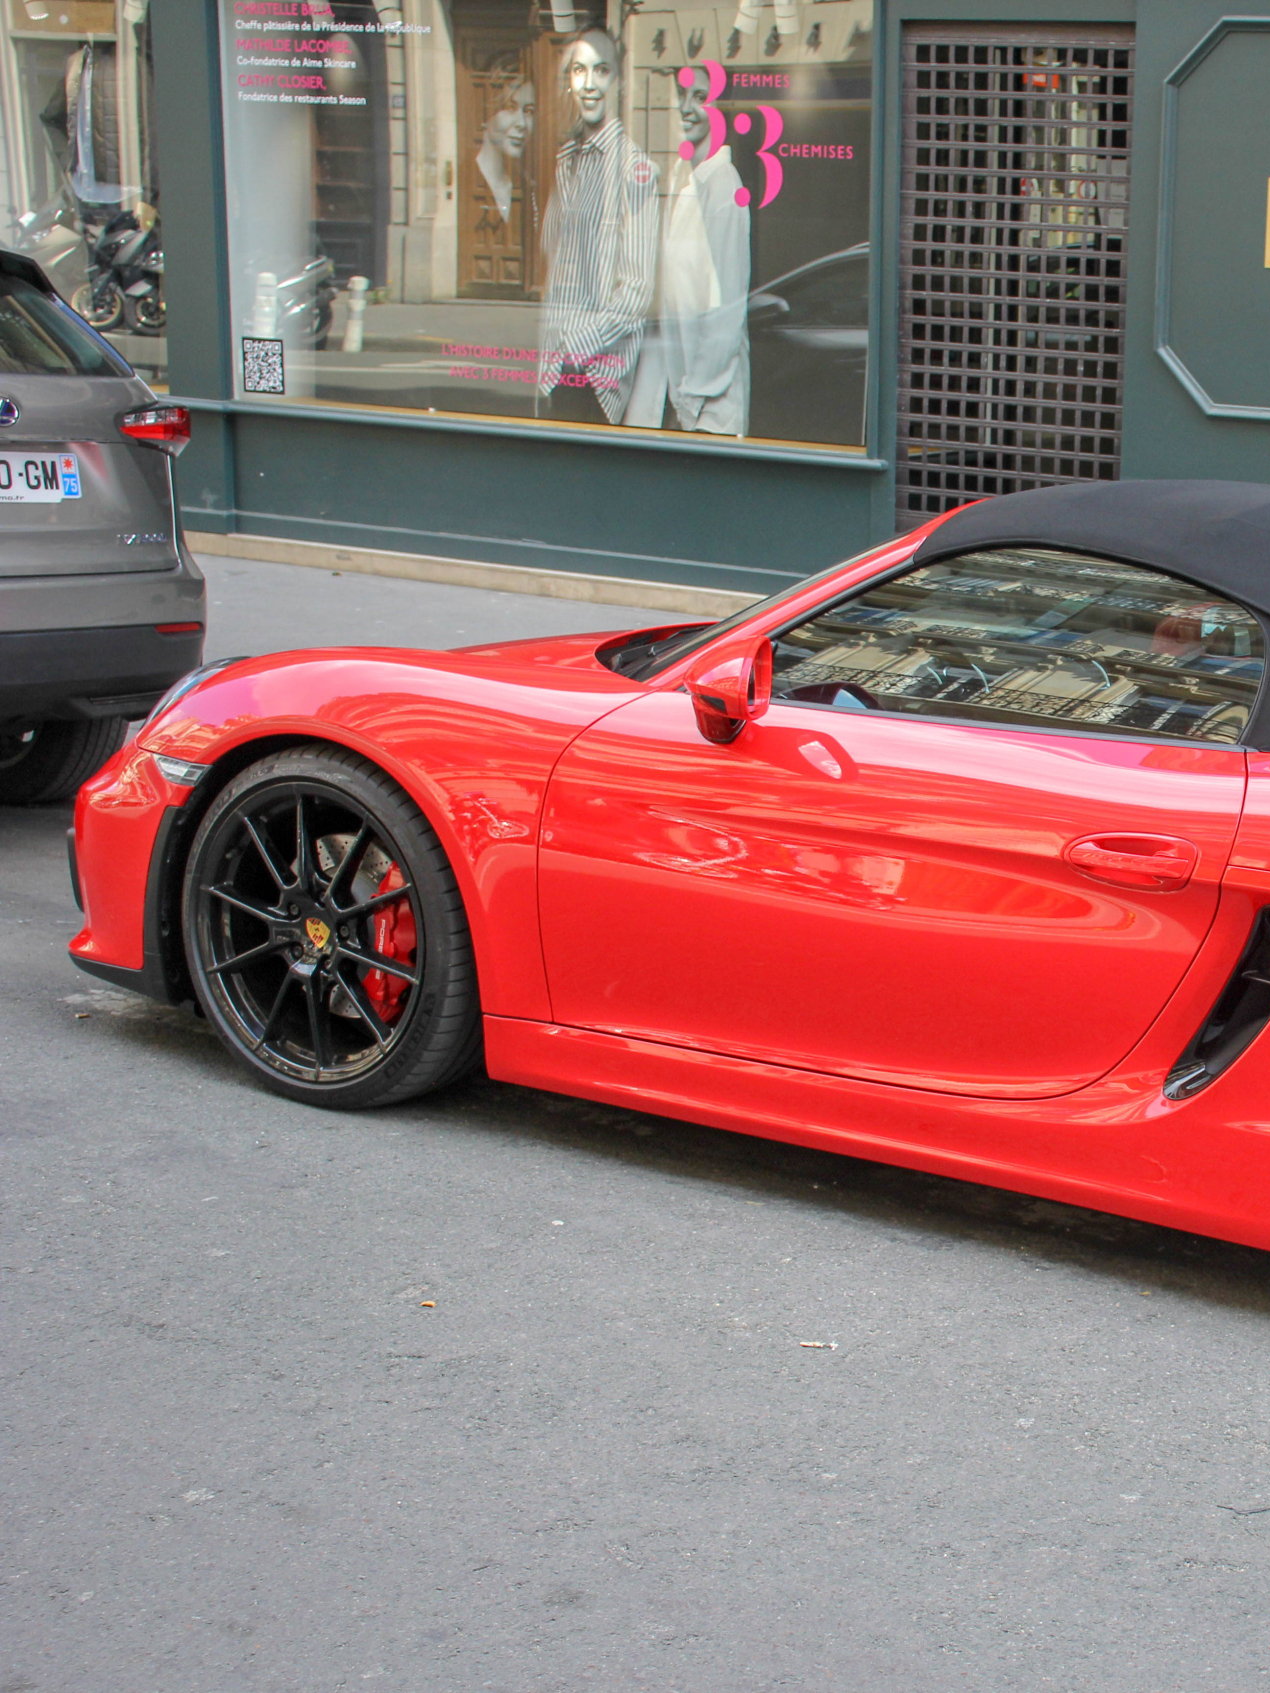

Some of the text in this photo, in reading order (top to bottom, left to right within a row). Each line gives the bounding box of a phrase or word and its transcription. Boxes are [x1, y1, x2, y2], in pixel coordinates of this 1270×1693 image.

[234, 2, 299, 17] CHRISTELLE
[235, 20, 262, 31] Cheffe
[263, 20, 300, 32] pâtissière
[301, 21, 312, 32] de
[312, 22, 321, 32] la
[321, 21, 364, 33] Présidence
[365, 22, 376, 33] de
[376, 23, 385, 33] la
[236, 39, 291, 52] MATHILDE
[236, 56, 356, 69] Co-fondatrice de Aime Skincare
[238, 75, 327, 91] CATHY CLOSIER,
[238, 91, 367, 105] Fondatrice des restaurants Season
[677, 59, 791, 162] 3 FEMMES
[732, 105, 854, 210] 3 CHEMISES
[441, 344, 500, 360] L'HISTOIRE
[502, 349, 539, 363] D'UNE
[449, 366, 479, 380] AVEC
[482, 367, 490, 380] 3
[491, 367, 538, 384] FEMMES
[63, 478, 78, 493] 75
